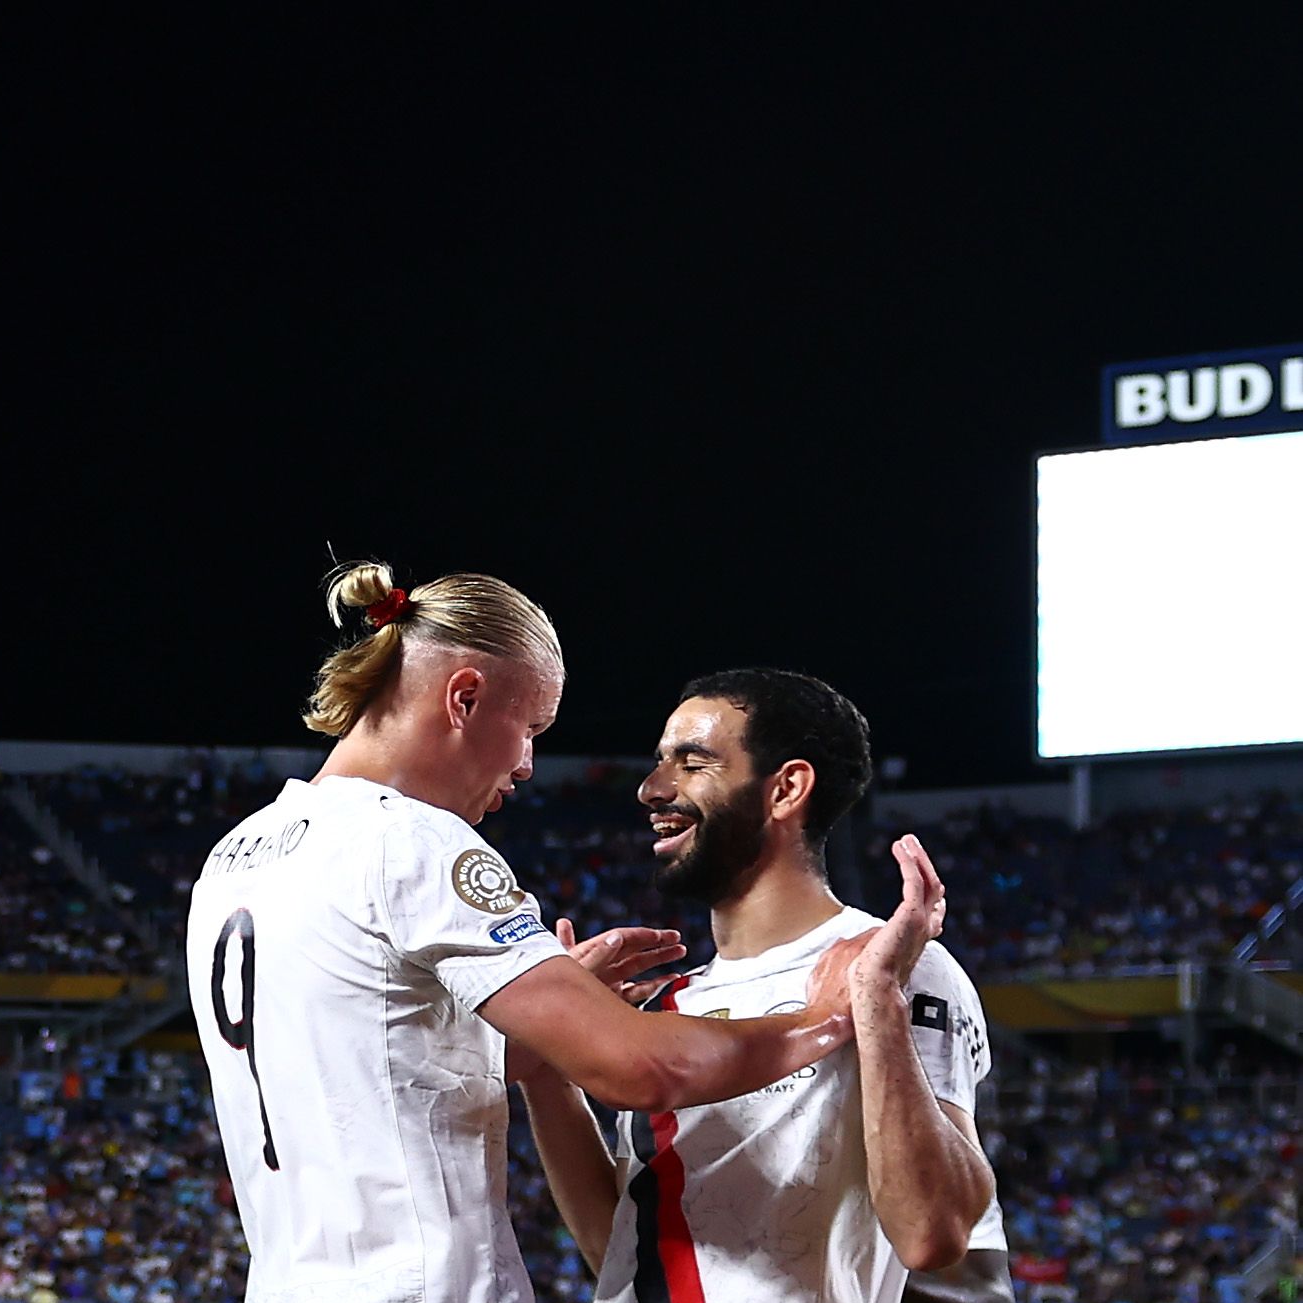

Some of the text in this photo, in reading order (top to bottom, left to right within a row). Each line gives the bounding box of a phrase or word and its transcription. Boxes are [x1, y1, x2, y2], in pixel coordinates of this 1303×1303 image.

[1115, 363, 1273, 428] BUD
[488, 895, 515, 911] FIFA
[211, 907, 280, 1171] 9
